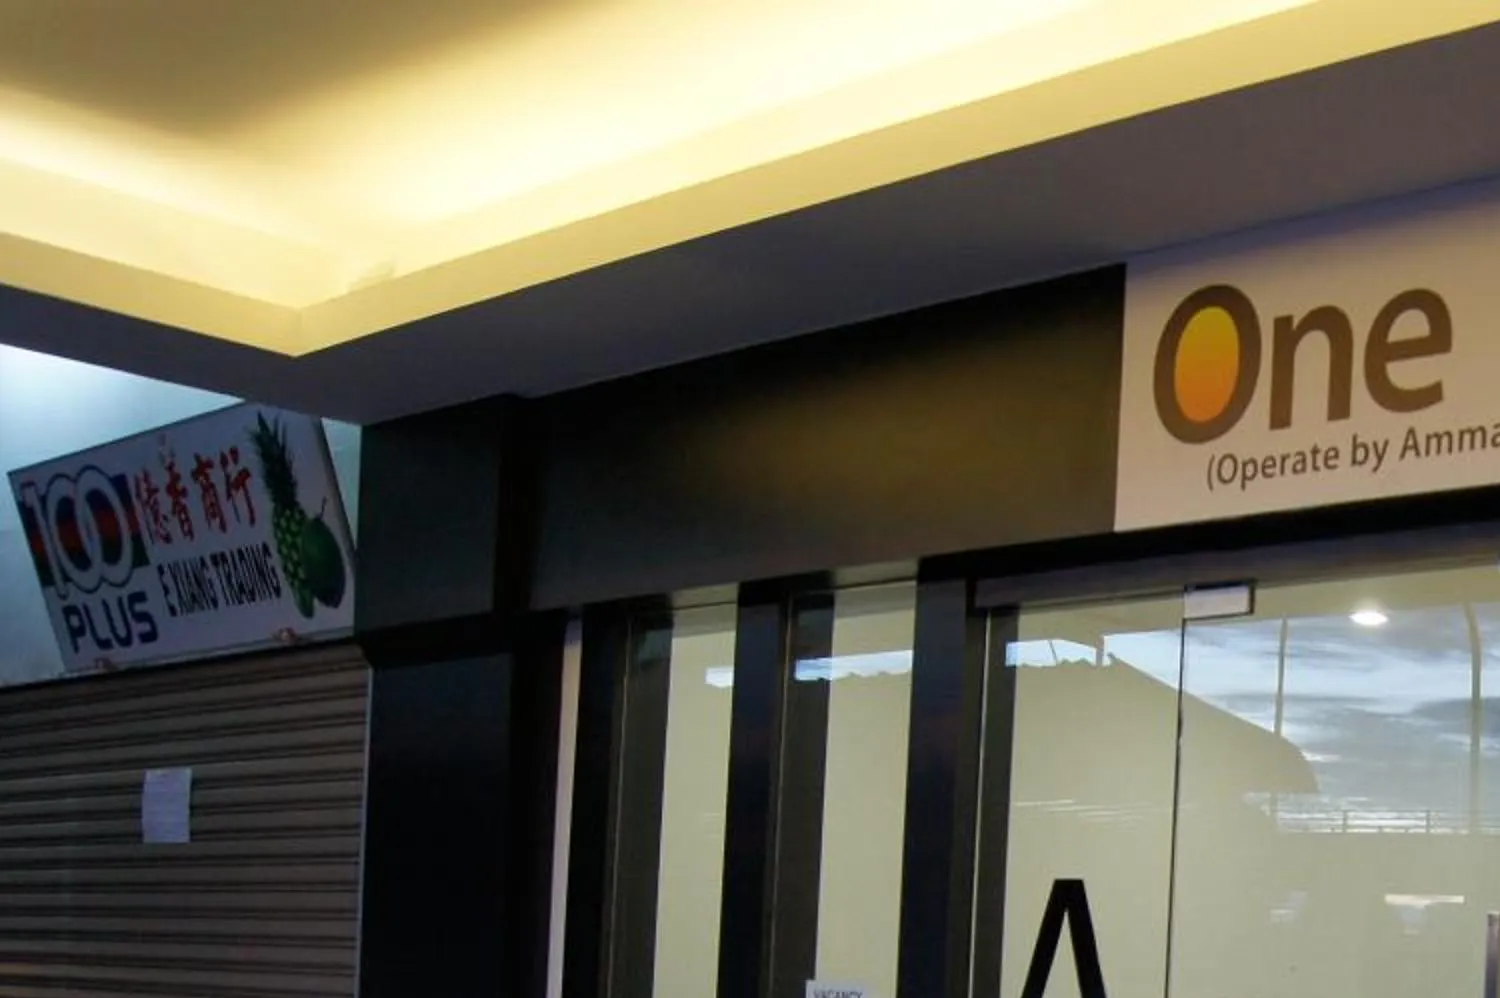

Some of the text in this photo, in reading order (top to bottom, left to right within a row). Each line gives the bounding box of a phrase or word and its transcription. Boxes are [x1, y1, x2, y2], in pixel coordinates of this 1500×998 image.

[1153, 283, 1453, 445] One
[1207, 444, 1340, 491] (Operate
[1350, 434, 1390, 472] by
[20, 464, 134, 599] 100
[157, 542, 282, 616] E XIANG TRADING
[62, 590, 158, 653] PLUS
